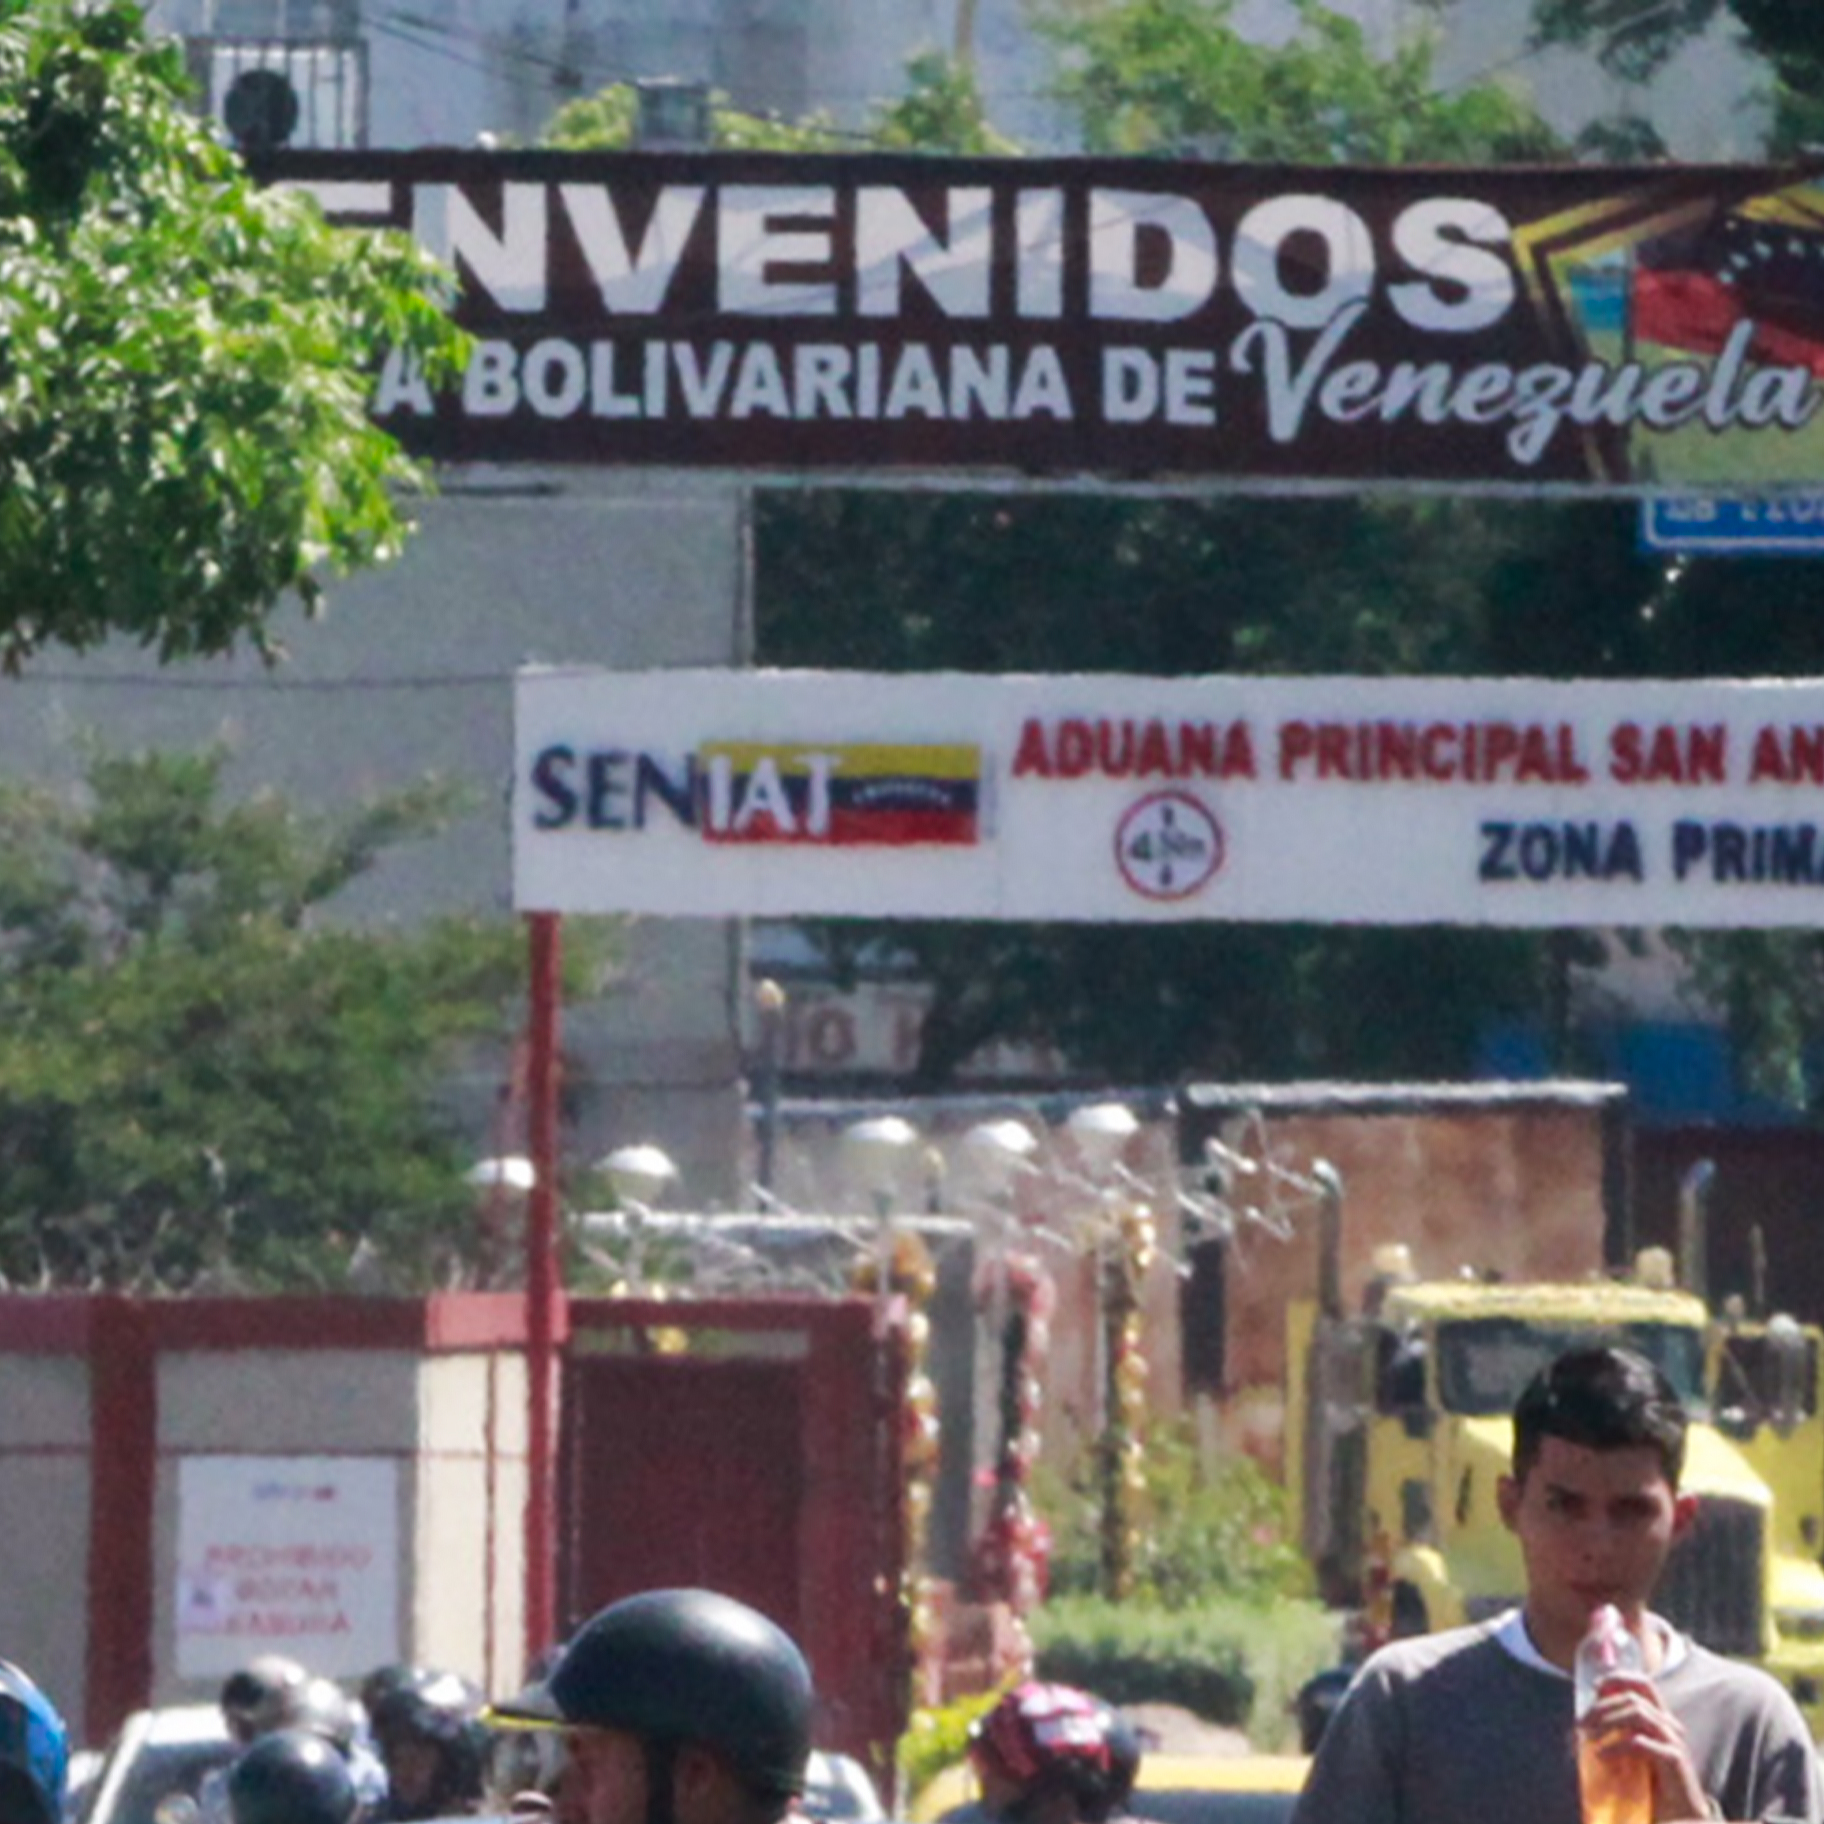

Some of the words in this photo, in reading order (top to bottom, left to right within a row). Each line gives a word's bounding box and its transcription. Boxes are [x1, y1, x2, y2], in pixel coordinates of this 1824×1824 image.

[269, 180, 1516, 332] NVENIDOS
[462, 337, 1073, 421] BOLIVARIANA
[1102, 347, 1216, 426] DE
[1230, 296, 1824, 465] Venezuela
[531, 743, 844, 836] SENIAT
[1011, 717, 1258, 780] ADUANA
[1278, 719, 1590, 785] PRINCIPAL
[1608, 722, 1728, 786] SAN
[1478, 820, 1644, 884] ZONA
